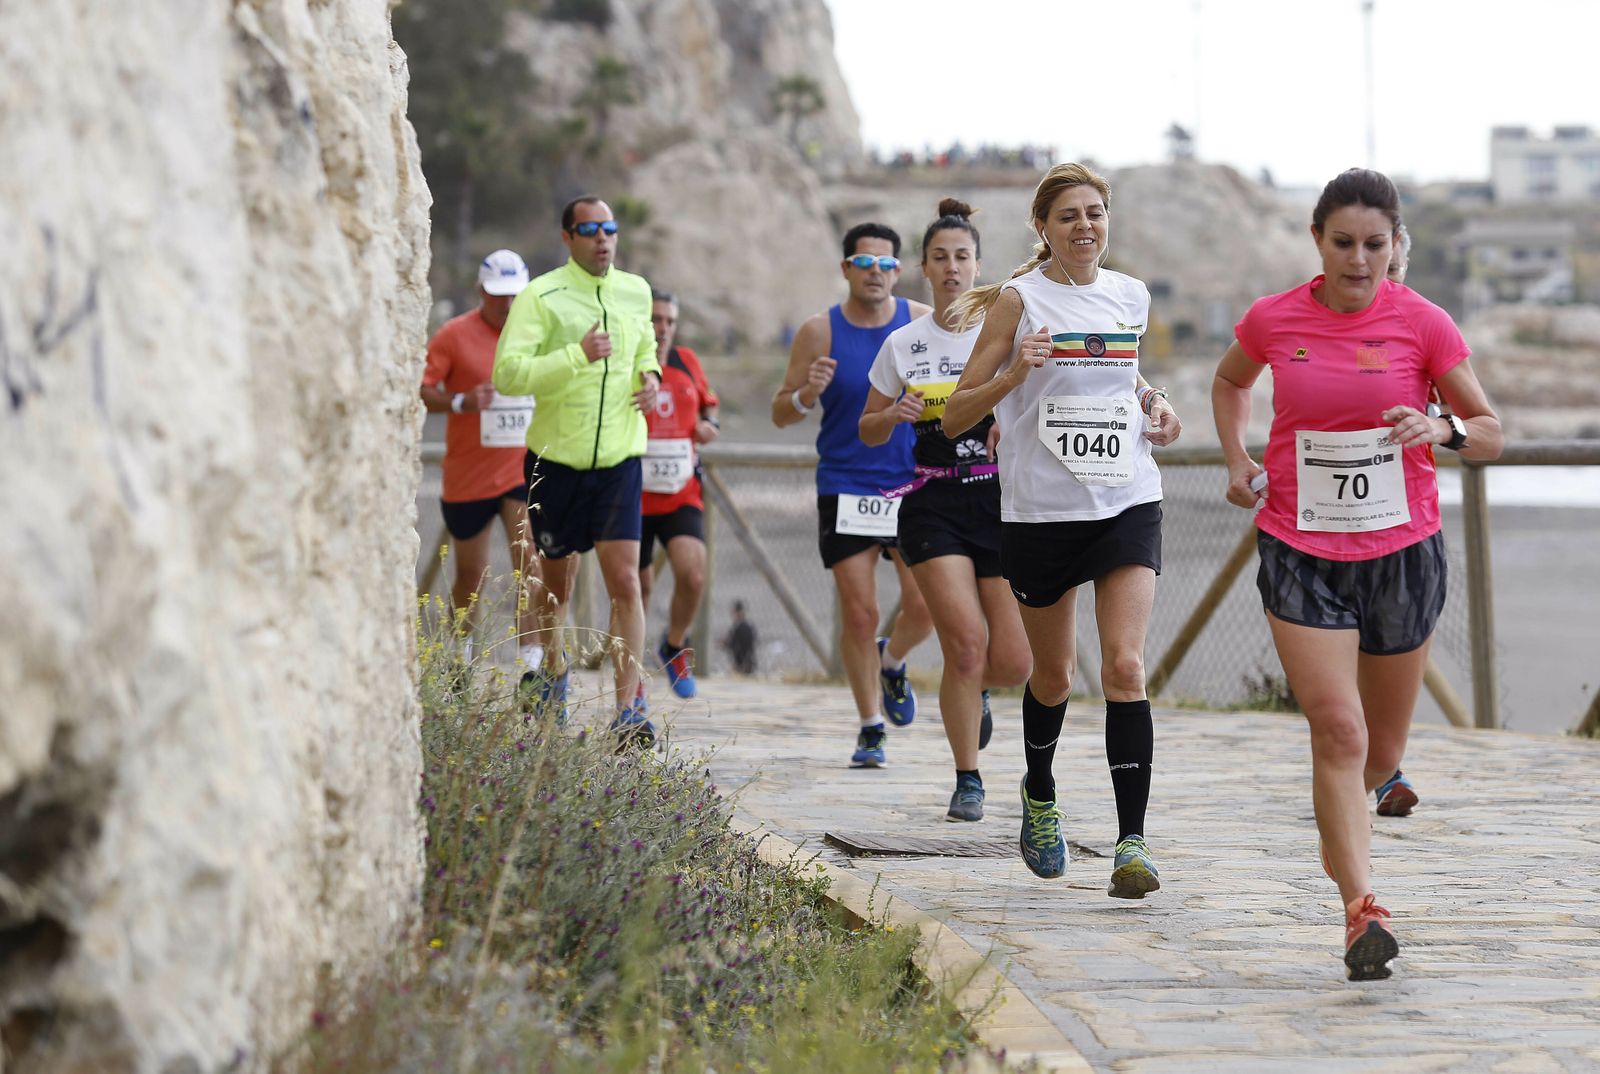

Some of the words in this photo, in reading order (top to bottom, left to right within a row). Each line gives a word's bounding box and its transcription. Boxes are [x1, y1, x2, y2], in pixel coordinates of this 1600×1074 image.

[1055, 358, 1134, 368] www.injerateams.com
[497, 414, 525, 429] 338
[1056, 432, 1120, 458] 1040
[650, 462, 680, 477] 323
[1333, 473, 1369, 500] 70
[858, 497, 894, 516] 607
[1351, 513, 1378, 522] POPULAR
